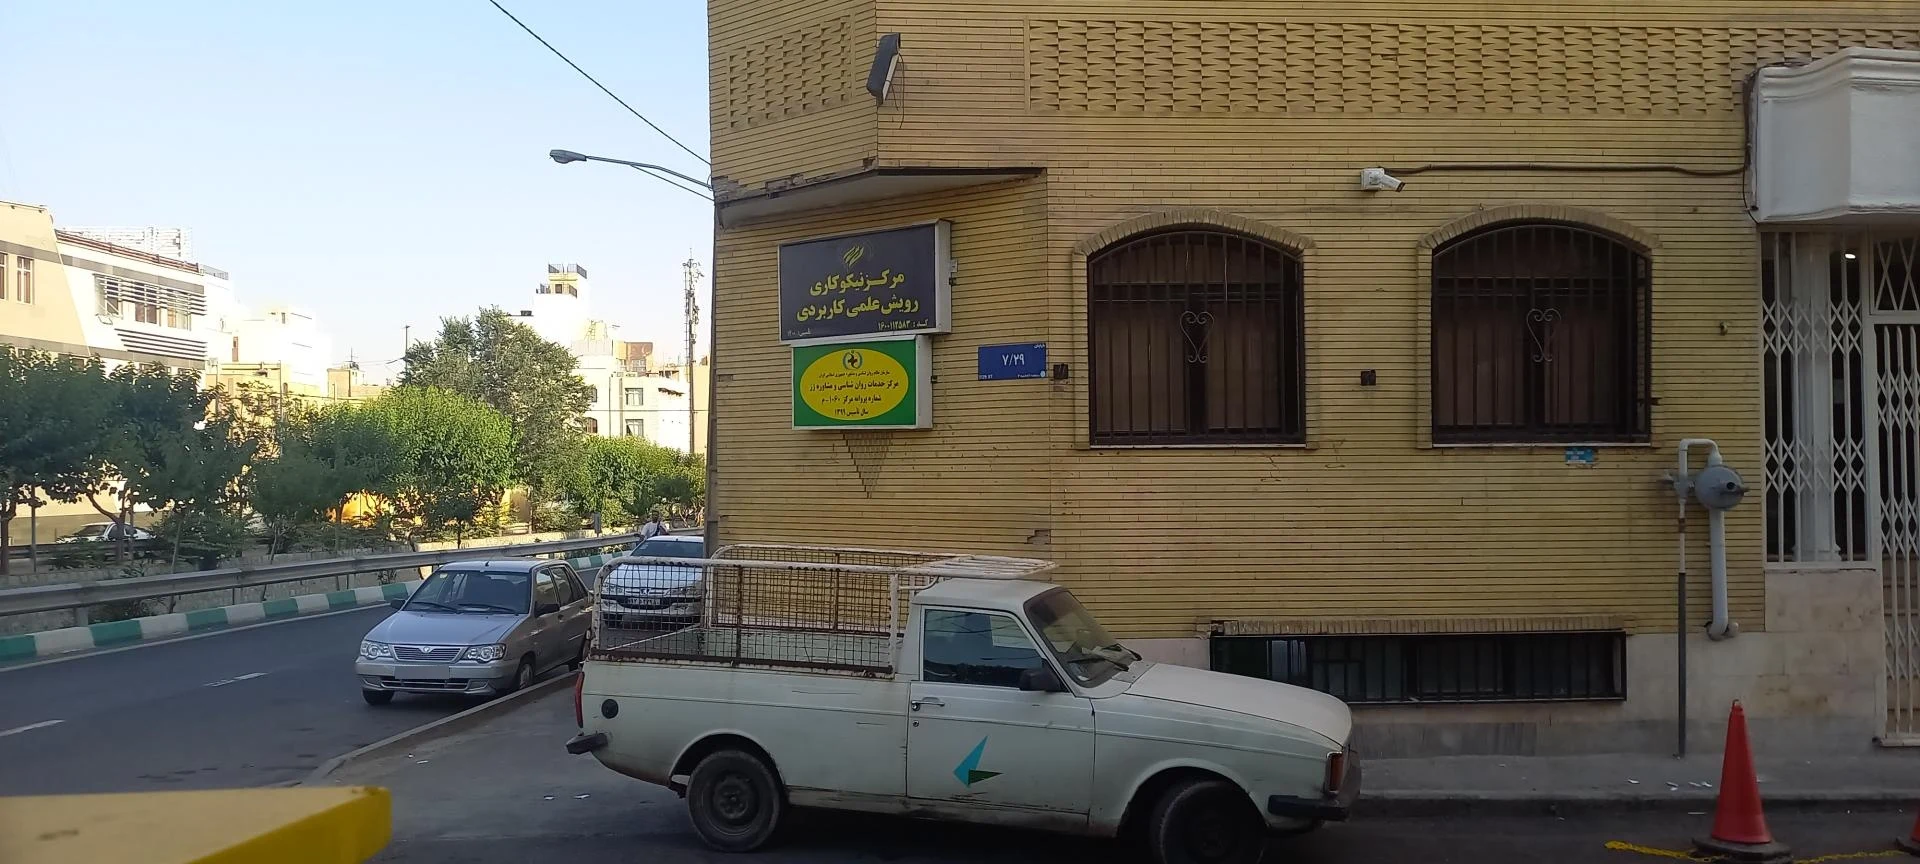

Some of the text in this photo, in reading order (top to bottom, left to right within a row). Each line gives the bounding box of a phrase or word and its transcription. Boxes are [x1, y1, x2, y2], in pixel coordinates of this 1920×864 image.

[810, 272, 865, 296] نیکوکاری
[796, 293, 919, 322] رویش علمی کاربردی
[816, 381, 833, 391] مشاوره
[838, 381, 854, 391] شناسی
[855, 380, 867, 390] روان
[867, 379, 885, 389] خدمات
[886, 379, 899, 389] مرکز
